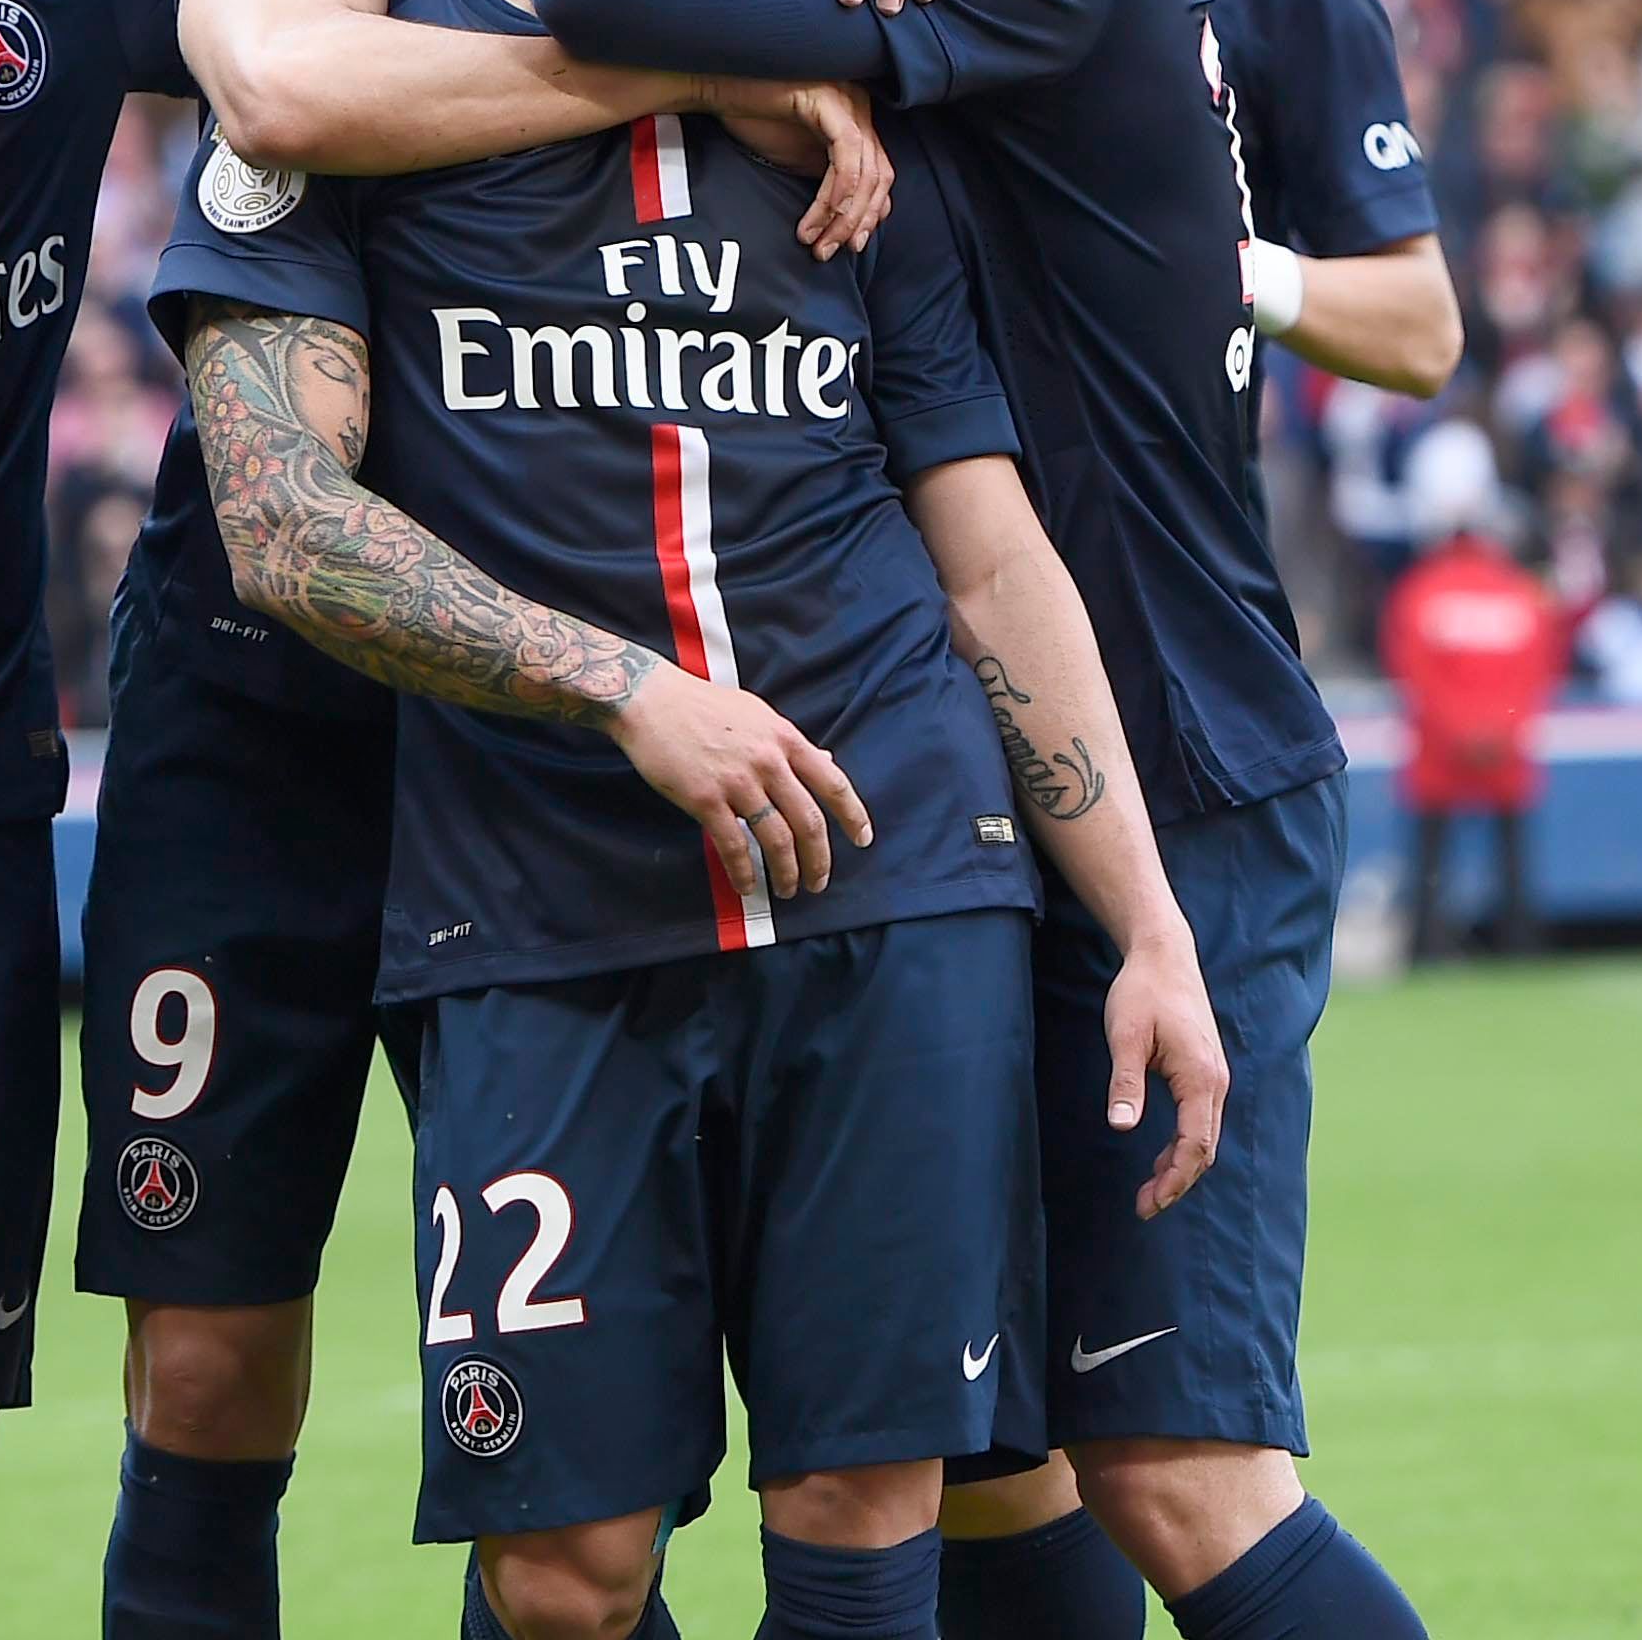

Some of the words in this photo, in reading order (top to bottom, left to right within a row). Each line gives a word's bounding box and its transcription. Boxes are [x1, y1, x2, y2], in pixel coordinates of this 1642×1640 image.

[599, 235, 740, 313] Fly
[211, 616, 270, 642] DRI-FIT
[428, 921, 473, 946] DRI-FIT
[129, 968, 219, 1120] 9
[129, 1145, 183, 1169] PARIS
[426, 1171, 586, 1347] 22
[450, 1366, 500, 1392] PARIS
